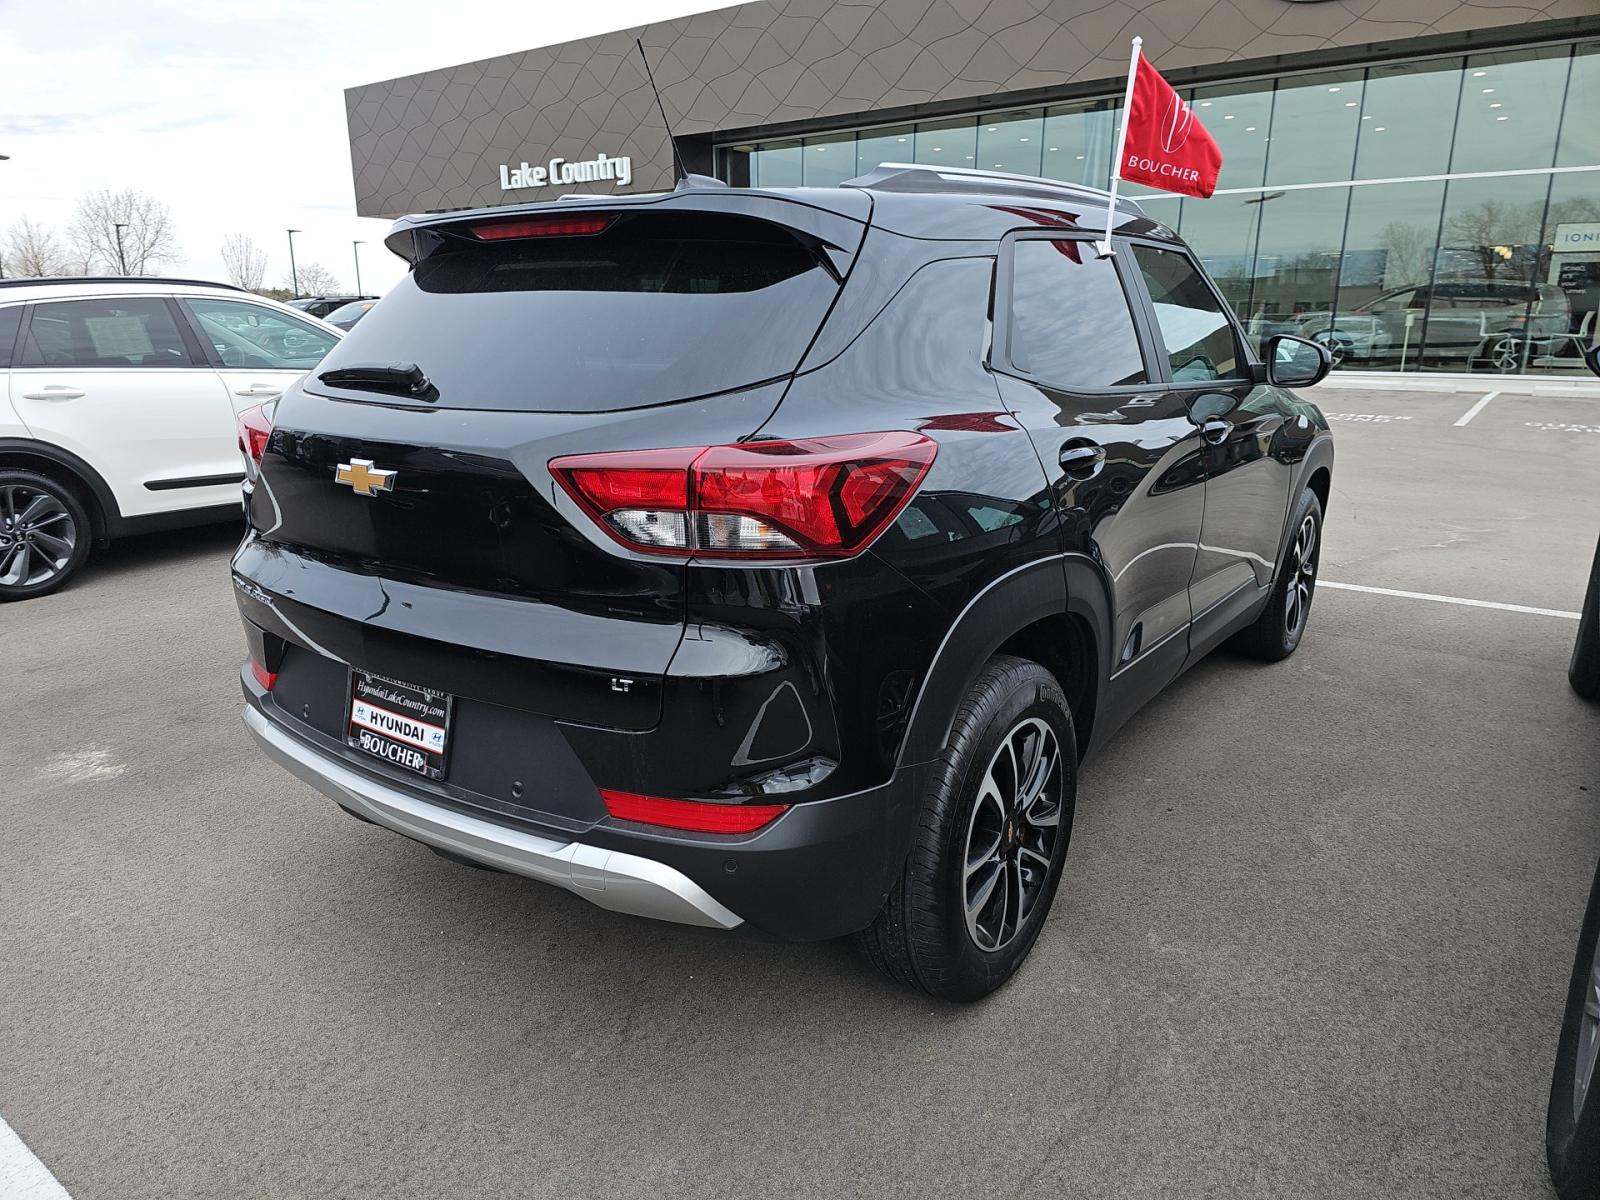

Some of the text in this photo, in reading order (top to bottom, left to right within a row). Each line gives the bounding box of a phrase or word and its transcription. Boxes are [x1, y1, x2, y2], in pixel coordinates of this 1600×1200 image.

[499, 153, 632, 190] Lake Country
[1128, 155, 1199, 182] BOUCHER
[357, 680, 445, 717] HyundaiLakeCountry.com
[611, 678, 634, 692] LT
[370, 711, 425, 741] HYUNDAI
[363, 734, 421, 769] BOUCHER
